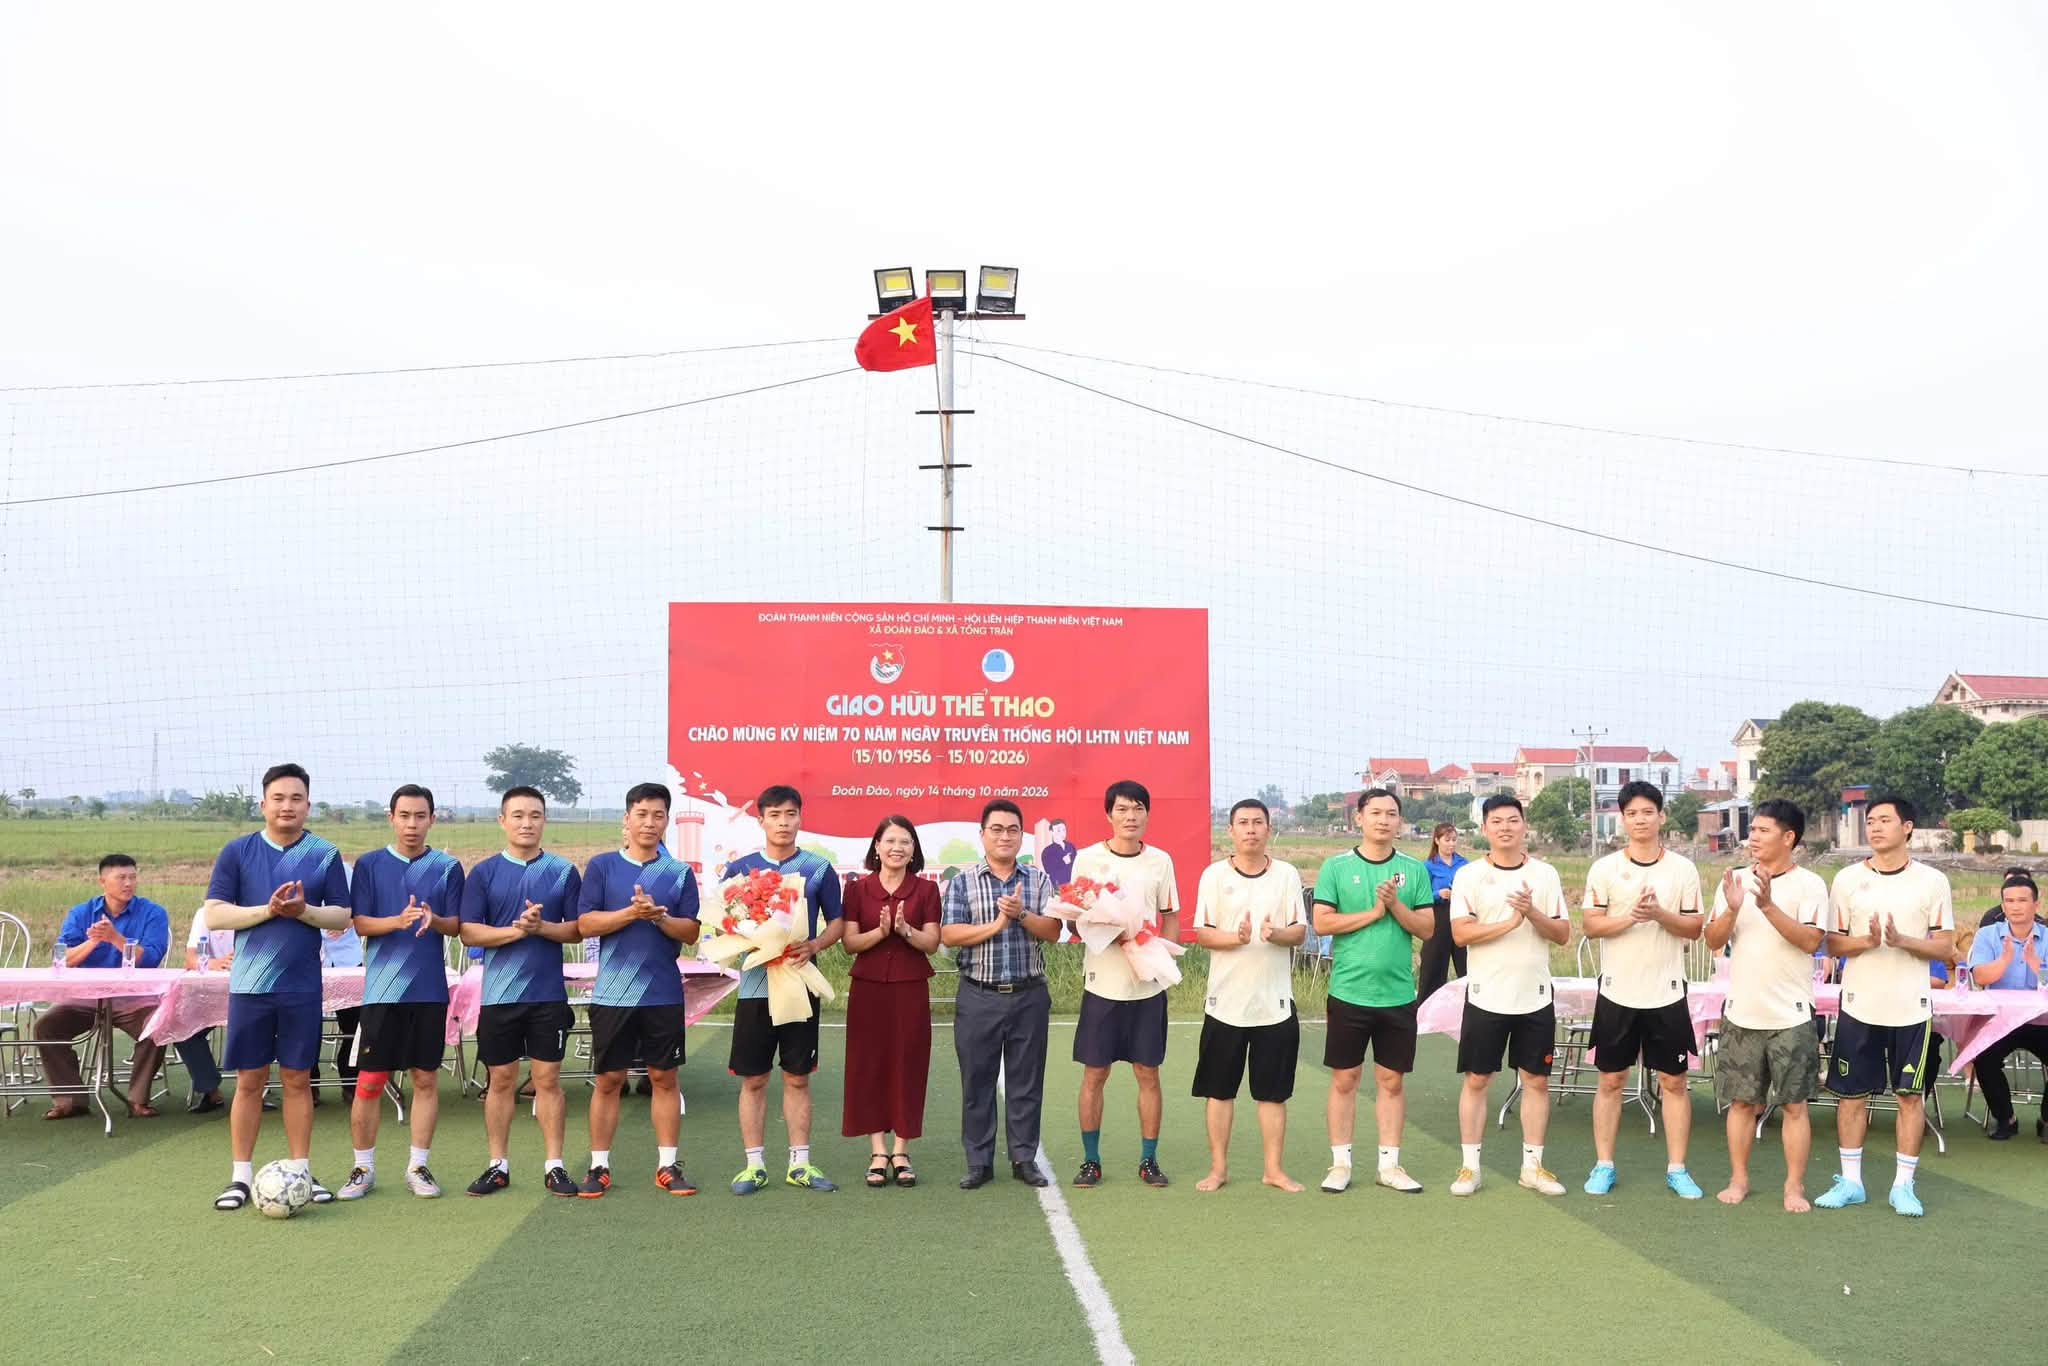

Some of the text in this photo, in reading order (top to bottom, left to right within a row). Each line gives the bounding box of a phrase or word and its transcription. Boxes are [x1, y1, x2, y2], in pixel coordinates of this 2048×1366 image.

[789, 613, 819, 623] THANH
[822, 611, 842, 623] NIÊN
[844, 611, 874, 624] CỘNG
[876, 611, 894, 623] SẢN
[897, 611, 911, 623] HỒ
[913, 612, 929, 624] CHÍ
[931, 614, 955, 624] MINH
[964, 612, 981, 625] HỘI
[983, 613, 1002, 624] LIÊN
[1004, 613, 1024, 625] HIỆP
[1026, 615, 1057, 625] THANH
[1059, 613, 1079, 625] NIÊN
[1081, 615, 1101, 627] VIỆT
[1102, 617, 1123, 626] NAM
[869, 623, 882, 634] XÃ
[946, 624, 958, 634] XÃ
[826, 688, 1055, 717] GIAO HỮU THỂ THAO
[688, 723, 1189, 746] CHÀO MỪNG KỶ NIỆM 70 NĂM NGÀY TRUYỀN THỐNG HỘI LHTN VIỆT NAM
[851, 748, 932, 767] (15/10/1956
[948, 749, 1031, 766] 15/10/2026)
[832, 785, 1049, 799] Đoàn Đào, ngày 14 tháng 10 năm 2026
